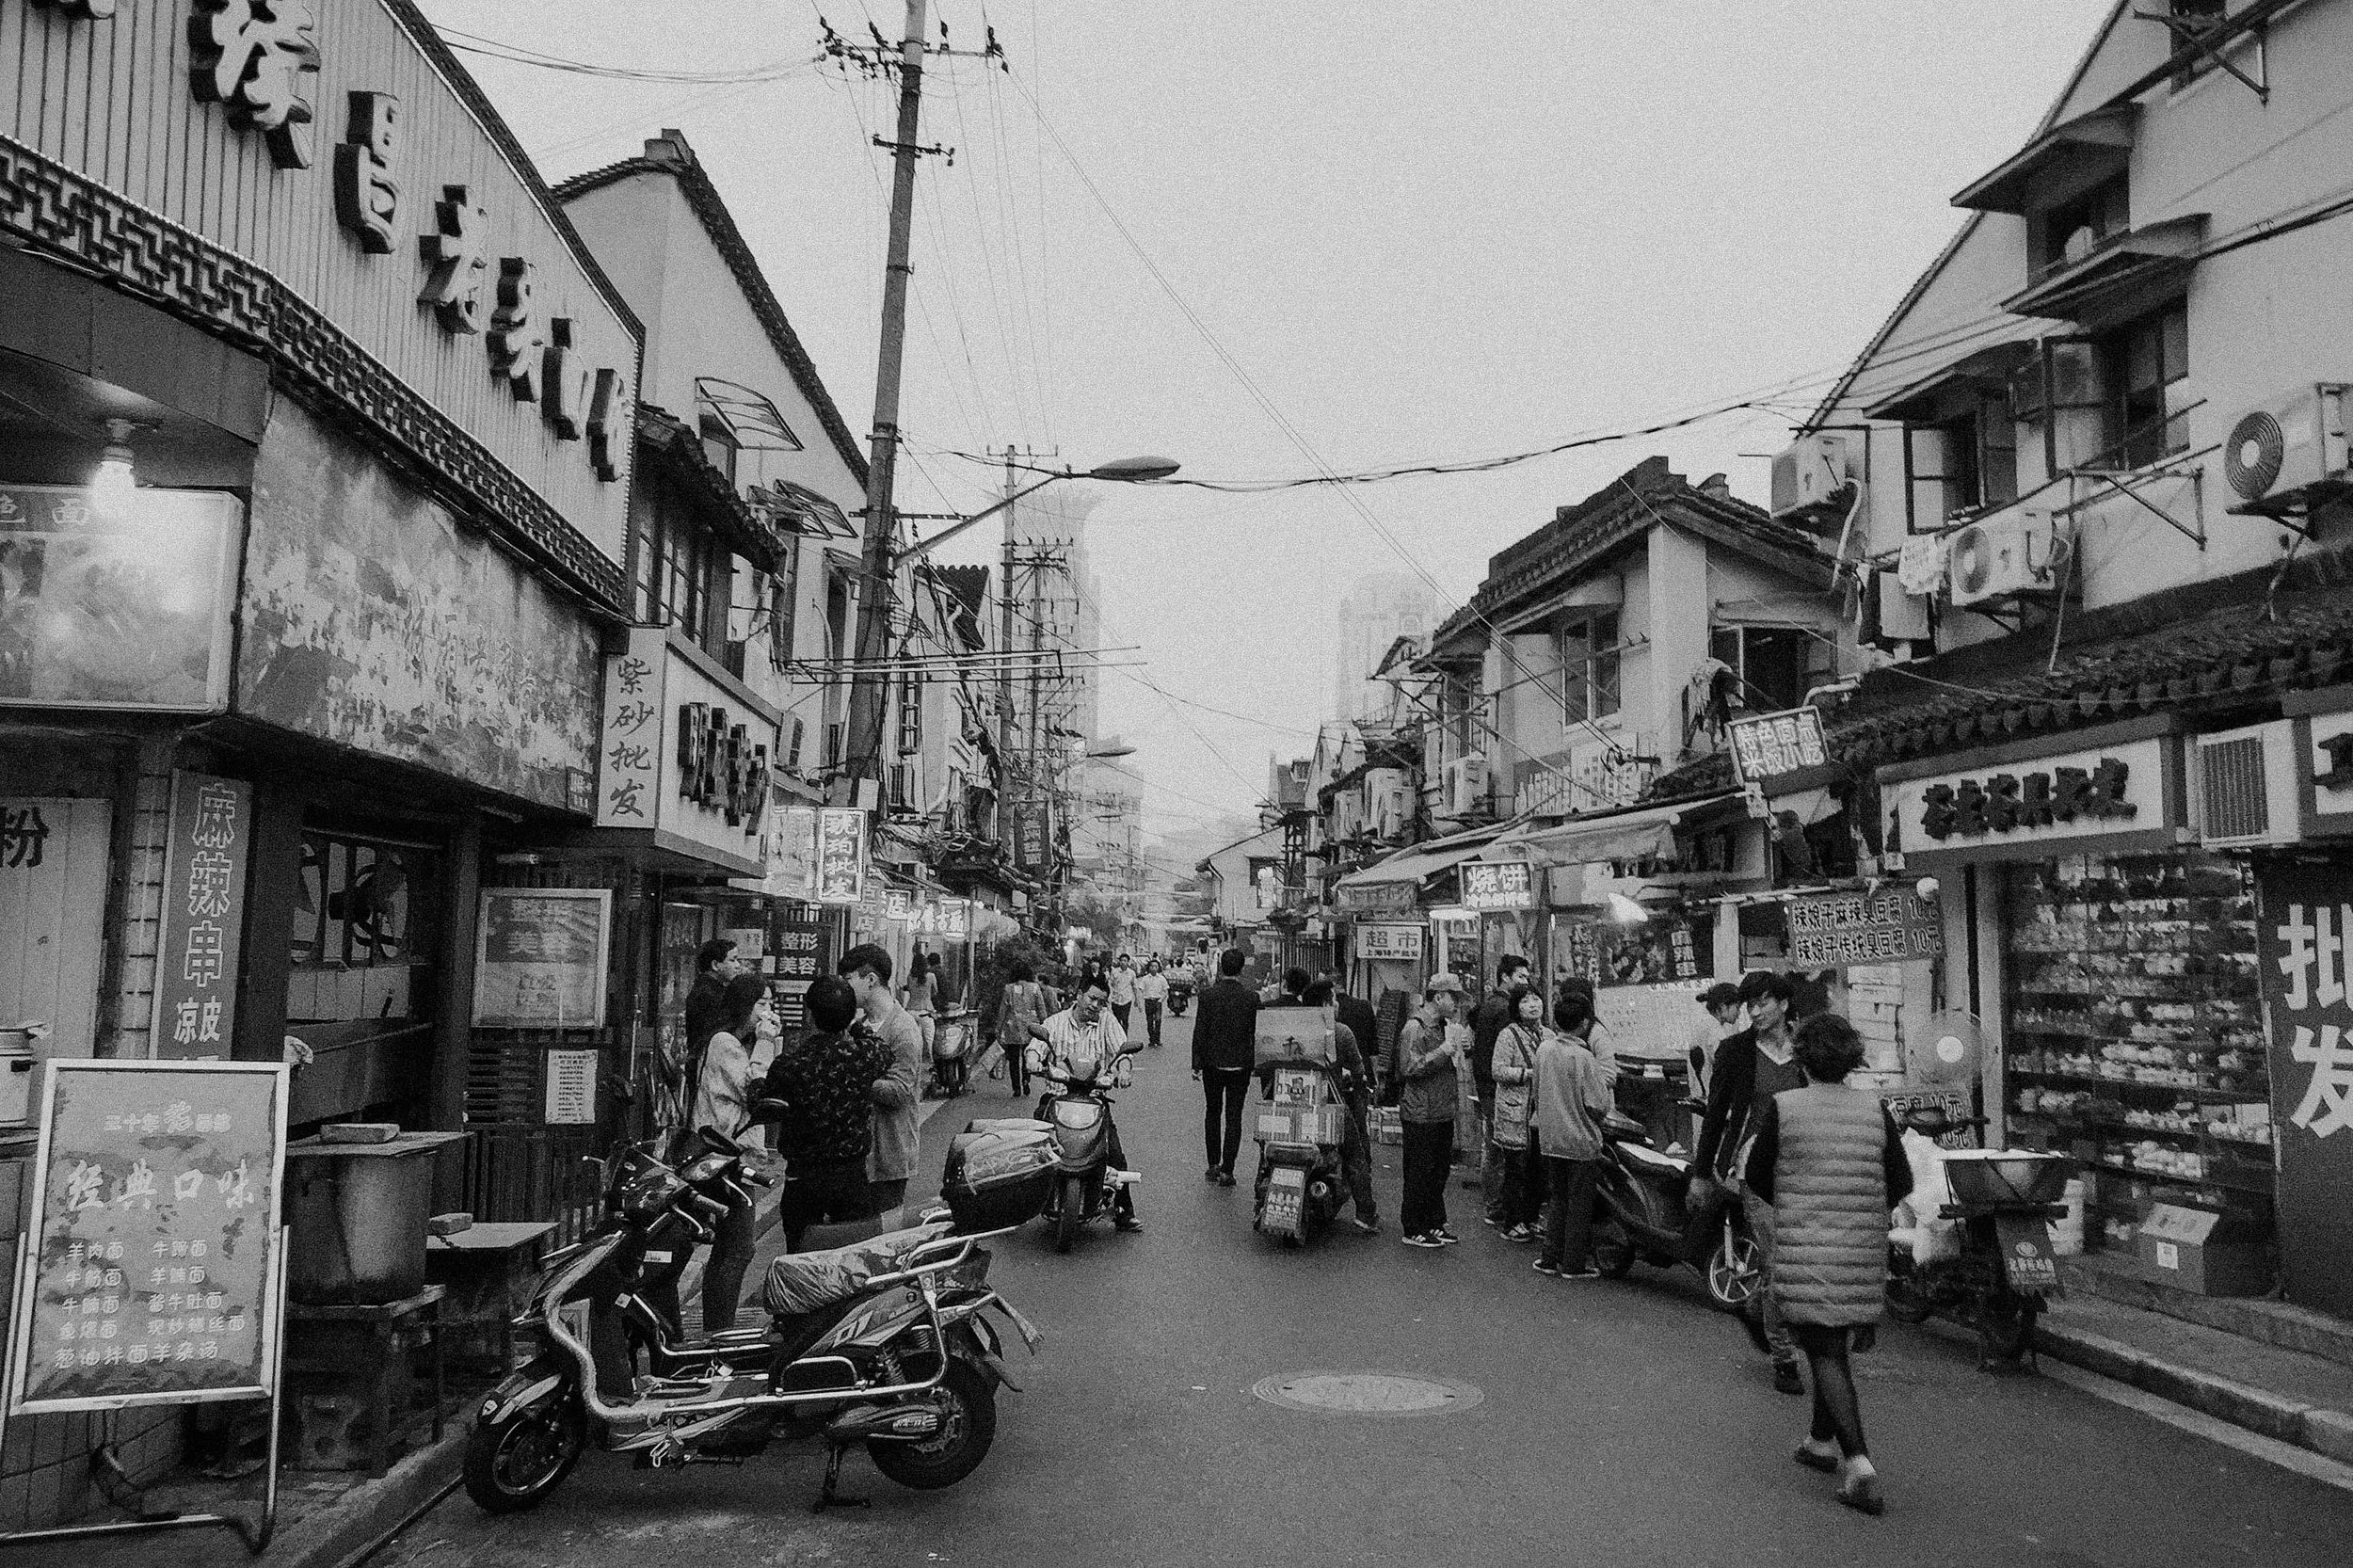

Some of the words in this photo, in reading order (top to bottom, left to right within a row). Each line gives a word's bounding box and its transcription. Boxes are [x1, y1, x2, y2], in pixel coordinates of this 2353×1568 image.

[609, 658, 654, 818] 紫砂批发
[0, 806, 49, 868] 粉
[184, 782, 236, 987] 麻辣串
[1466, 863, 1529, 893] 烧饼
[1791, 895, 1903, 933] 辣娘子麻辣臭豆腐
[781, 932, 818, 951] 整形
[1366, 930, 1419, 949] 超市
[1795, 927, 1908, 968] 辣娘子传统臭豆腐
[1912, 925, 1944, 953] 10元
[779, 956, 817, 975] 美容
[173, 995, 222, 1044] 凉皮
[67, 1159, 254, 1211] 经典口味
[67, 1241, 124, 1260] 羊肉面
